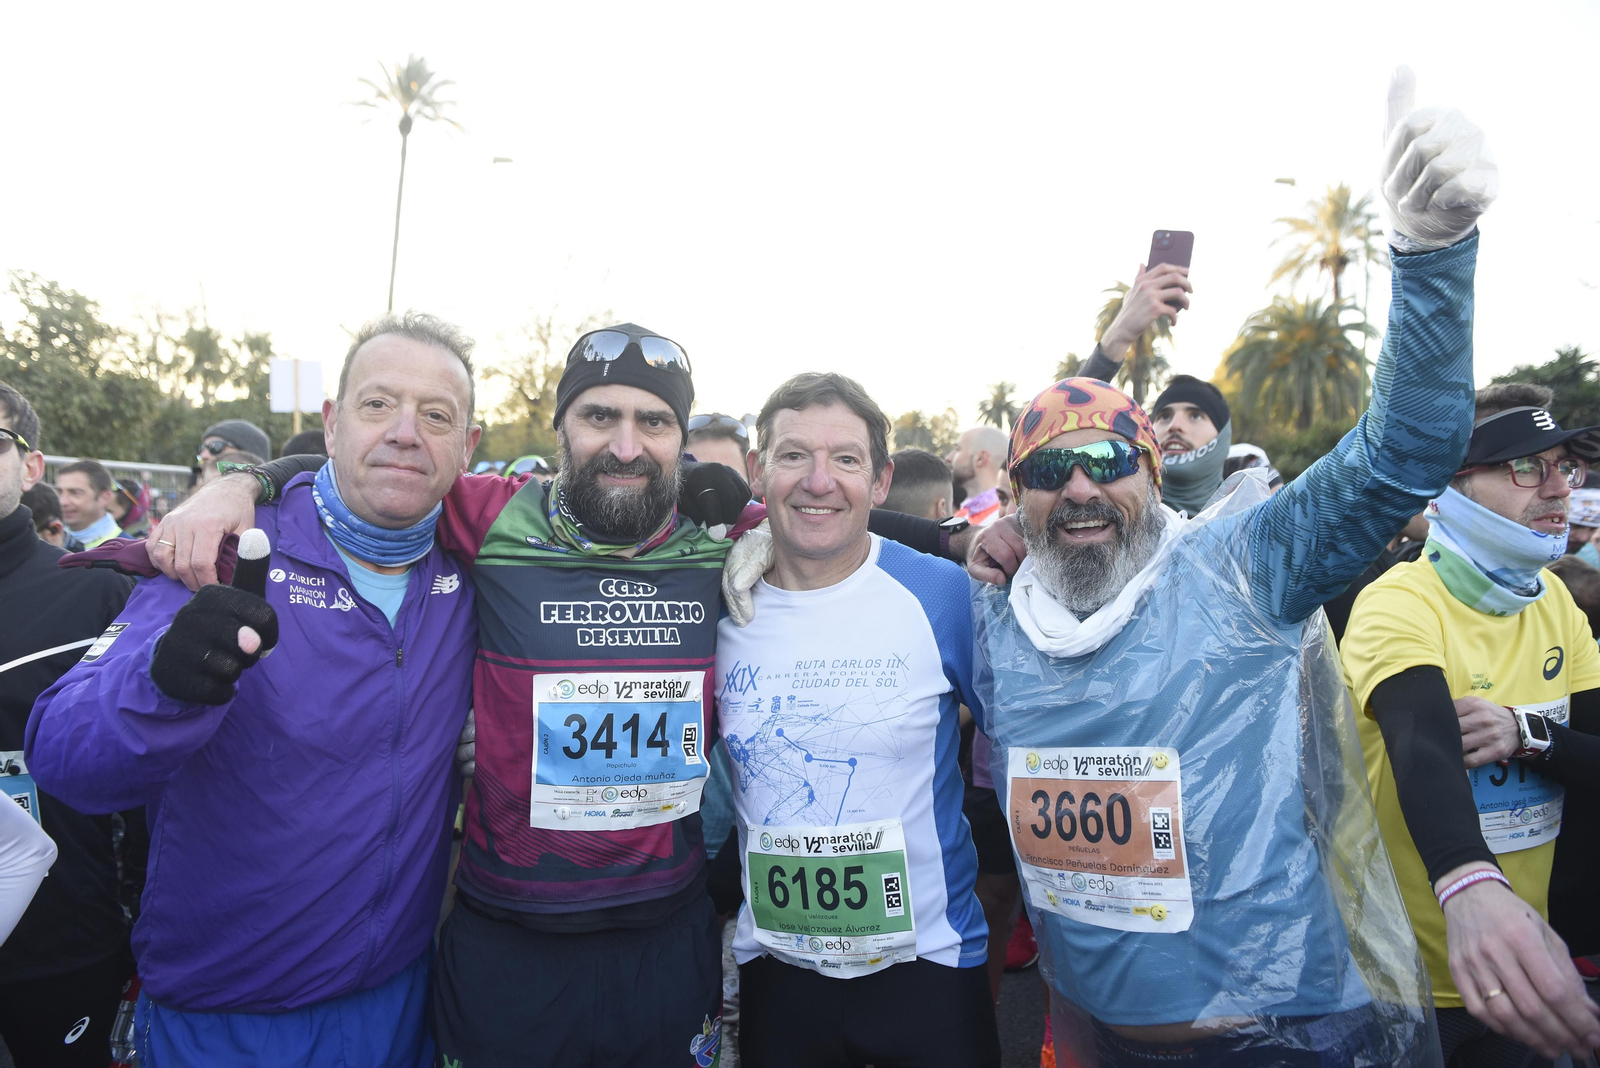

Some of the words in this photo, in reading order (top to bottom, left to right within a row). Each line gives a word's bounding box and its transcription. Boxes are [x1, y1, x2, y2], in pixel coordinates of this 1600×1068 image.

[288, 571, 325, 586] ZURICH
[289, 584, 326, 599] MARATÓN
[289, 594, 327, 609] SEVILLA
[540, 600, 705, 624] FERROVIARIO
[577, 628, 606, 646] DE
[606, 627, 681, 646] SEVILLA
[795, 659, 826, 670] RUTA
[831, 658, 882, 669] CARLOS
[757, 671, 820, 681] CARRERA
[791, 678, 841, 689] CIUDAD
[845, 678, 869, 688] DEL
[875, 678, 899, 688] SOL
[577, 679, 609, 698] edp
[631, 679, 682, 690] maratón
[643, 687, 682, 699] sevilla
[562, 712, 670, 760] 3414
[1043, 754, 1069, 775] edp
[1086, 754, 1142, 766] maratón
[1098, 764, 1142, 777] sevilla
[571, 774, 610, 783] Antonio
[613, 774, 642, 783] Ojeda
[645, 772, 676, 781] muñoz
[620, 785, 648, 801] edp
[1480, 800, 1510, 810] Antonio
[1533, 805, 1549, 820] edp
[1030, 789, 1132, 845] 3660
[774, 834, 800, 852] edp
[819, 832, 872, 845] maratón
[1508, 831, 1526, 840] HOKA
[832, 840, 874, 854] sevilla
[1068, 845, 1101, 854] PEÑUELAS
[1025, 853, 1064, 866] Francisco
[1066, 858, 1107, 871] Peñuelas
[1110, 864, 1170, 875] Domínguez
[767, 865, 868, 911] 6185
[1088, 875, 1115, 895] edp
[1062, 897, 1081, 907] HOKA
[797, 924, 842, 933] Velazquez
[845, 924, 881, 932] Álvarez
[825, 937, 851, 953] edp
